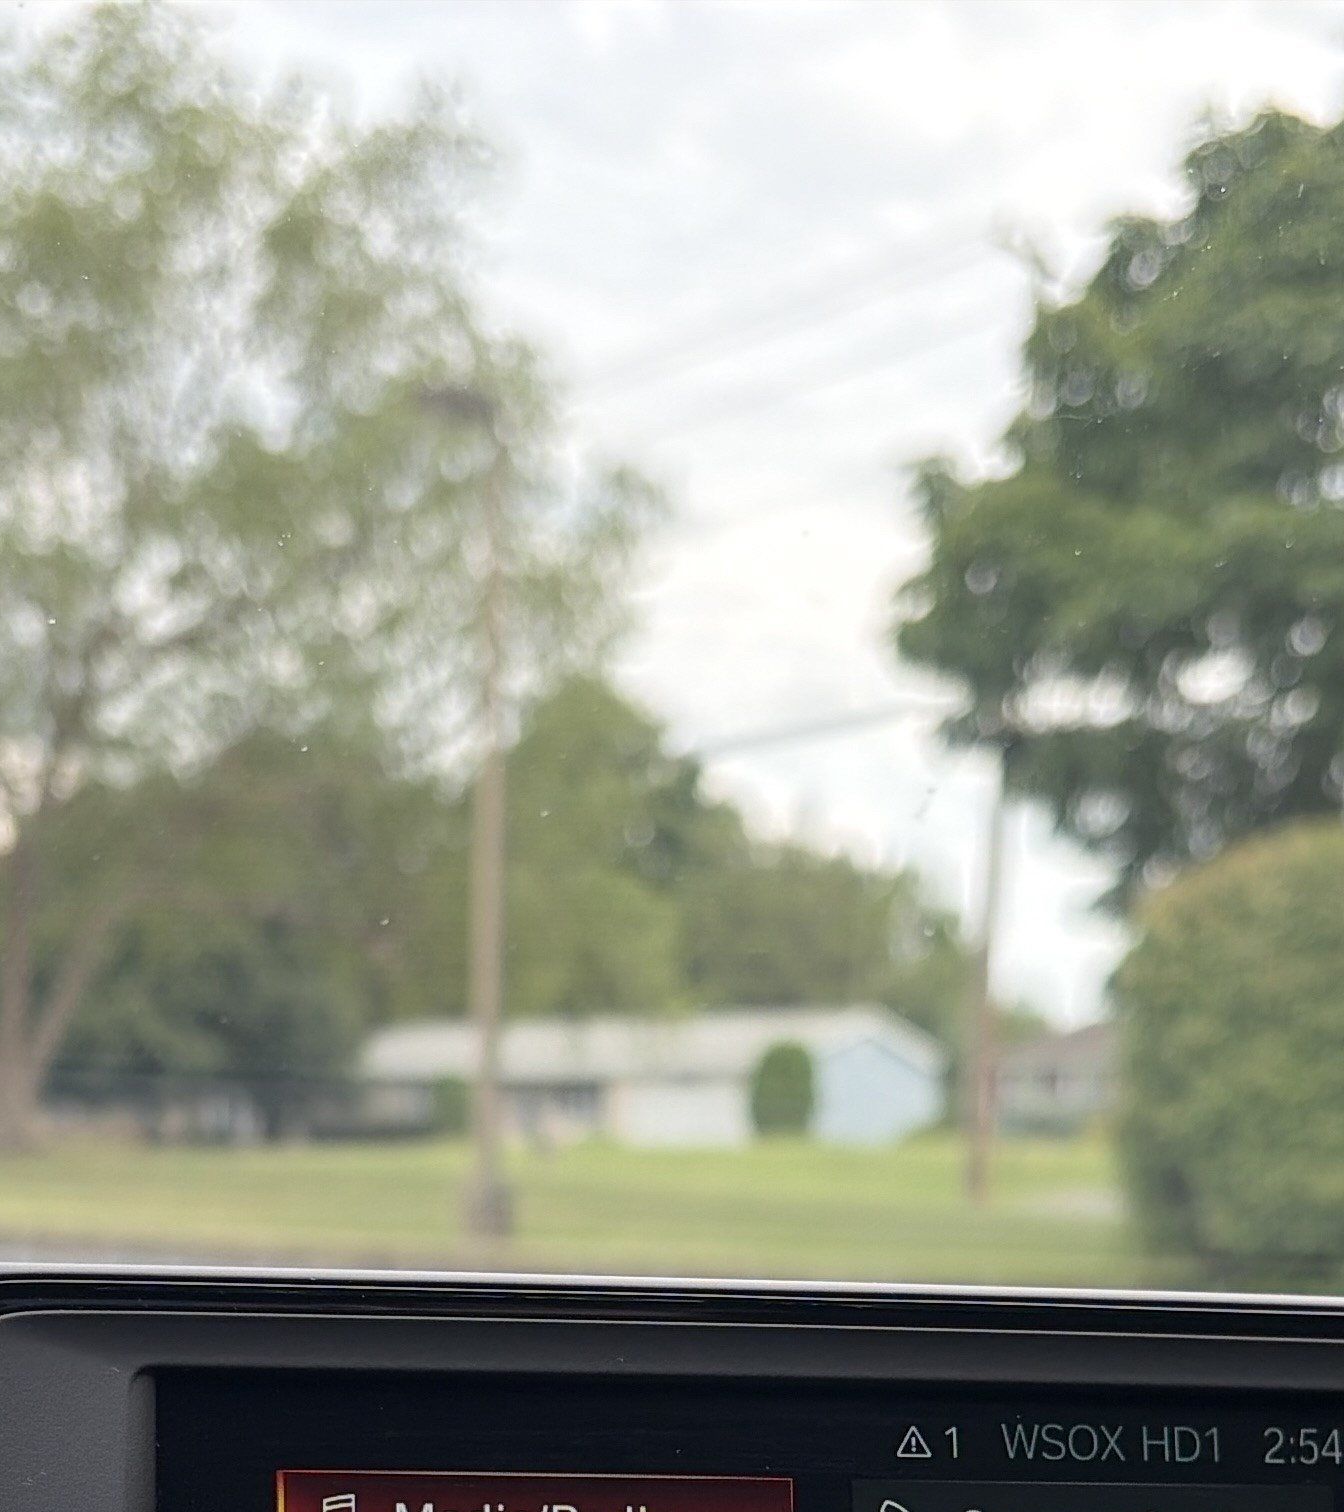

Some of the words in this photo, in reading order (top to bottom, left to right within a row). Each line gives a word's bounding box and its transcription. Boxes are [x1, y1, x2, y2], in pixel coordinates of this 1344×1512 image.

[944, 1426, 958, 1459] 1
[1000, 1423, 1126, 1461] WSOX
[1142, 1425, 1219, 1463] HD1
[1263, 1426, 1343, 1465] 2:54
